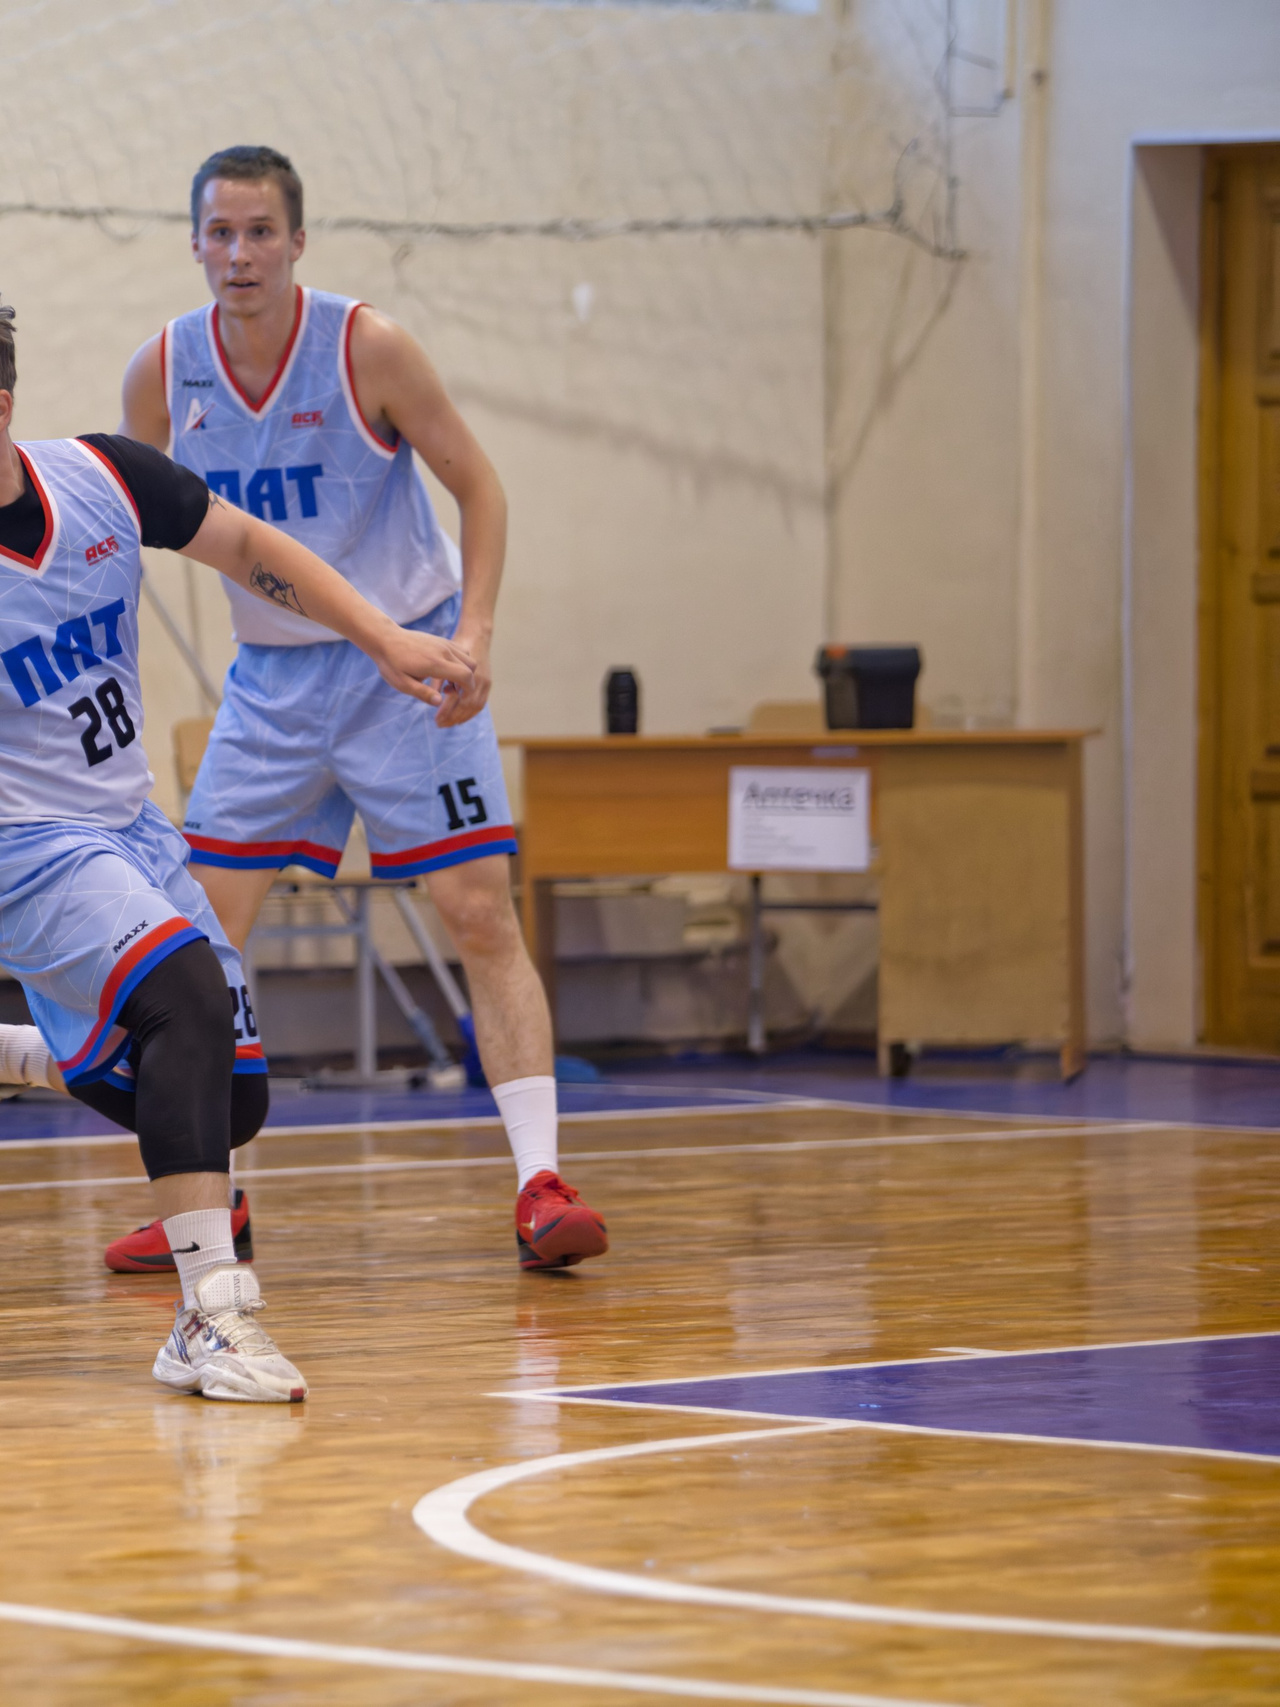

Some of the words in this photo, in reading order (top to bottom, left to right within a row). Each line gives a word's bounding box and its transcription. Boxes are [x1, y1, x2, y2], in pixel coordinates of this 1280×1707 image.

[205, 463, 324, 521] ПАТ
[0, 597, 126, 708] ПАТ
[67, 677, 135, 767] 28
[438, 777, 487, 831] 15
[113, 920, 148, 953] MAXX
